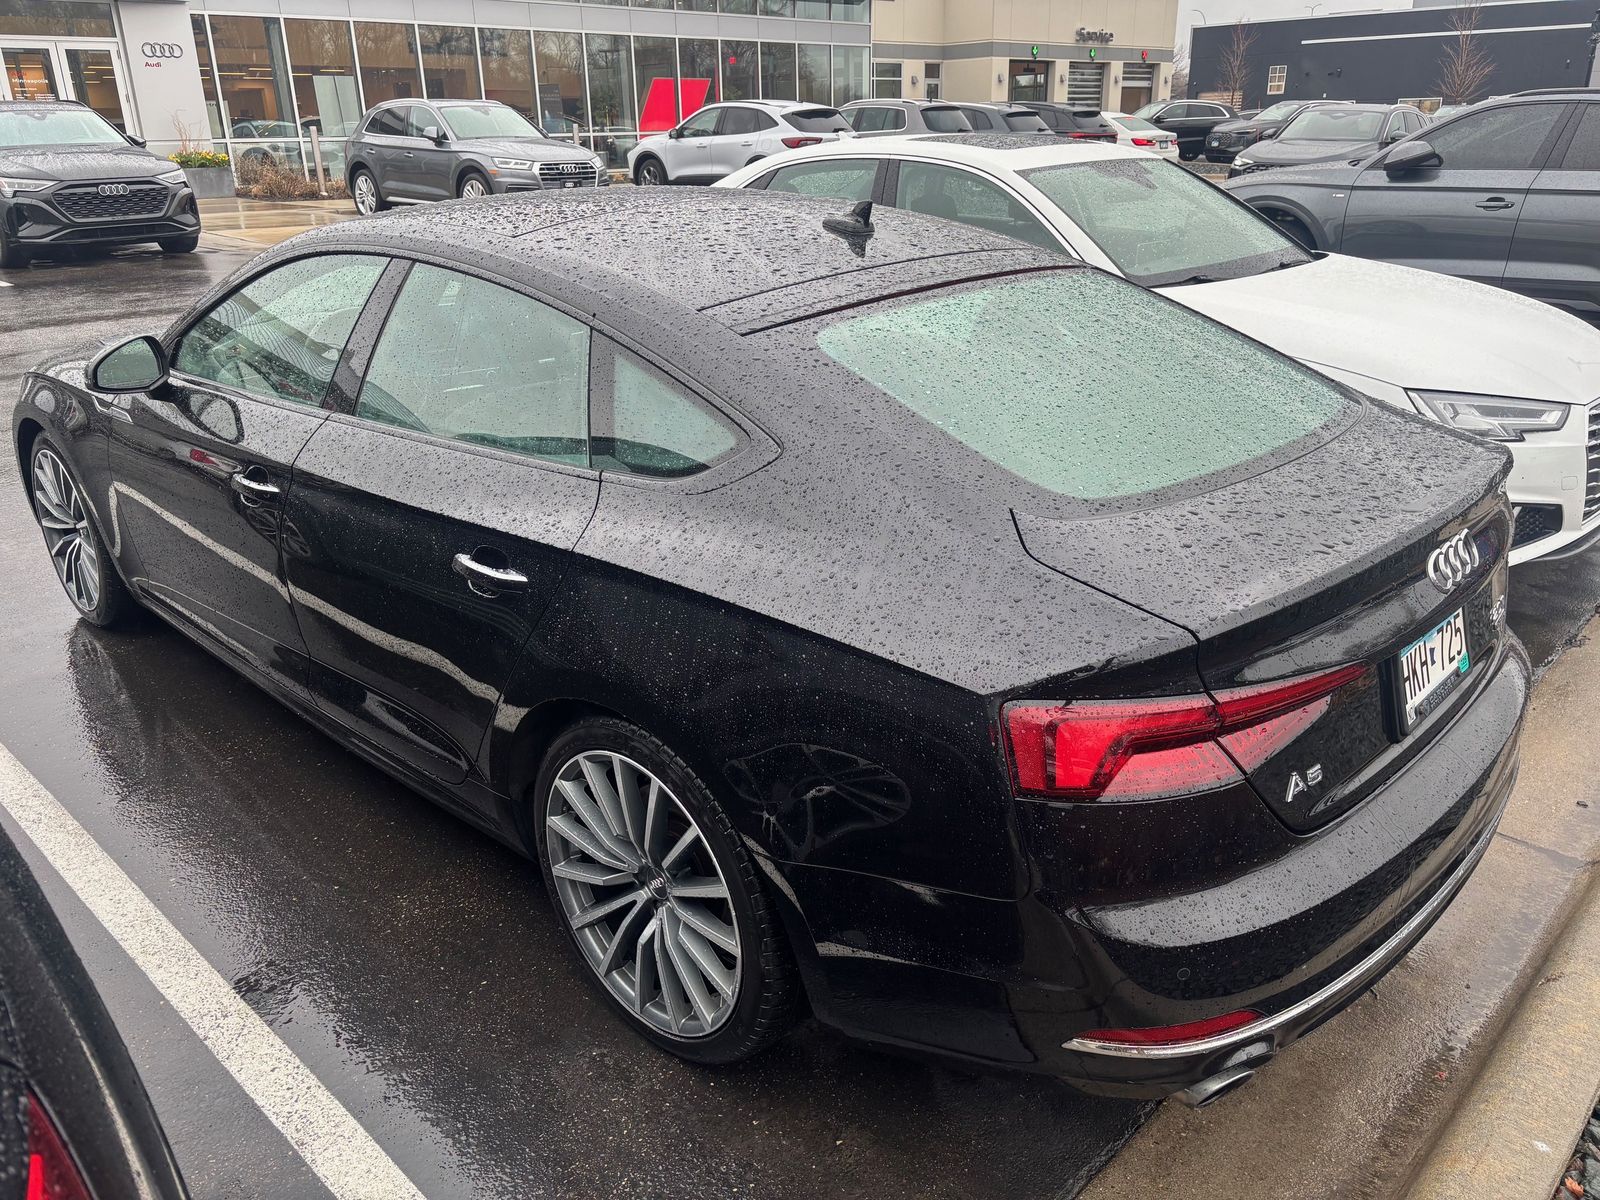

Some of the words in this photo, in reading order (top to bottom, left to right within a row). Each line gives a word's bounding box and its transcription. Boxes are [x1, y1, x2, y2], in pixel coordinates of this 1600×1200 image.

[1075, 27, 1114, 42] Service
[1401, 640, 1430, 704] HKH
[1436, 611, 1463, 671] 725
[1285, 763, 1323, 803] A5
